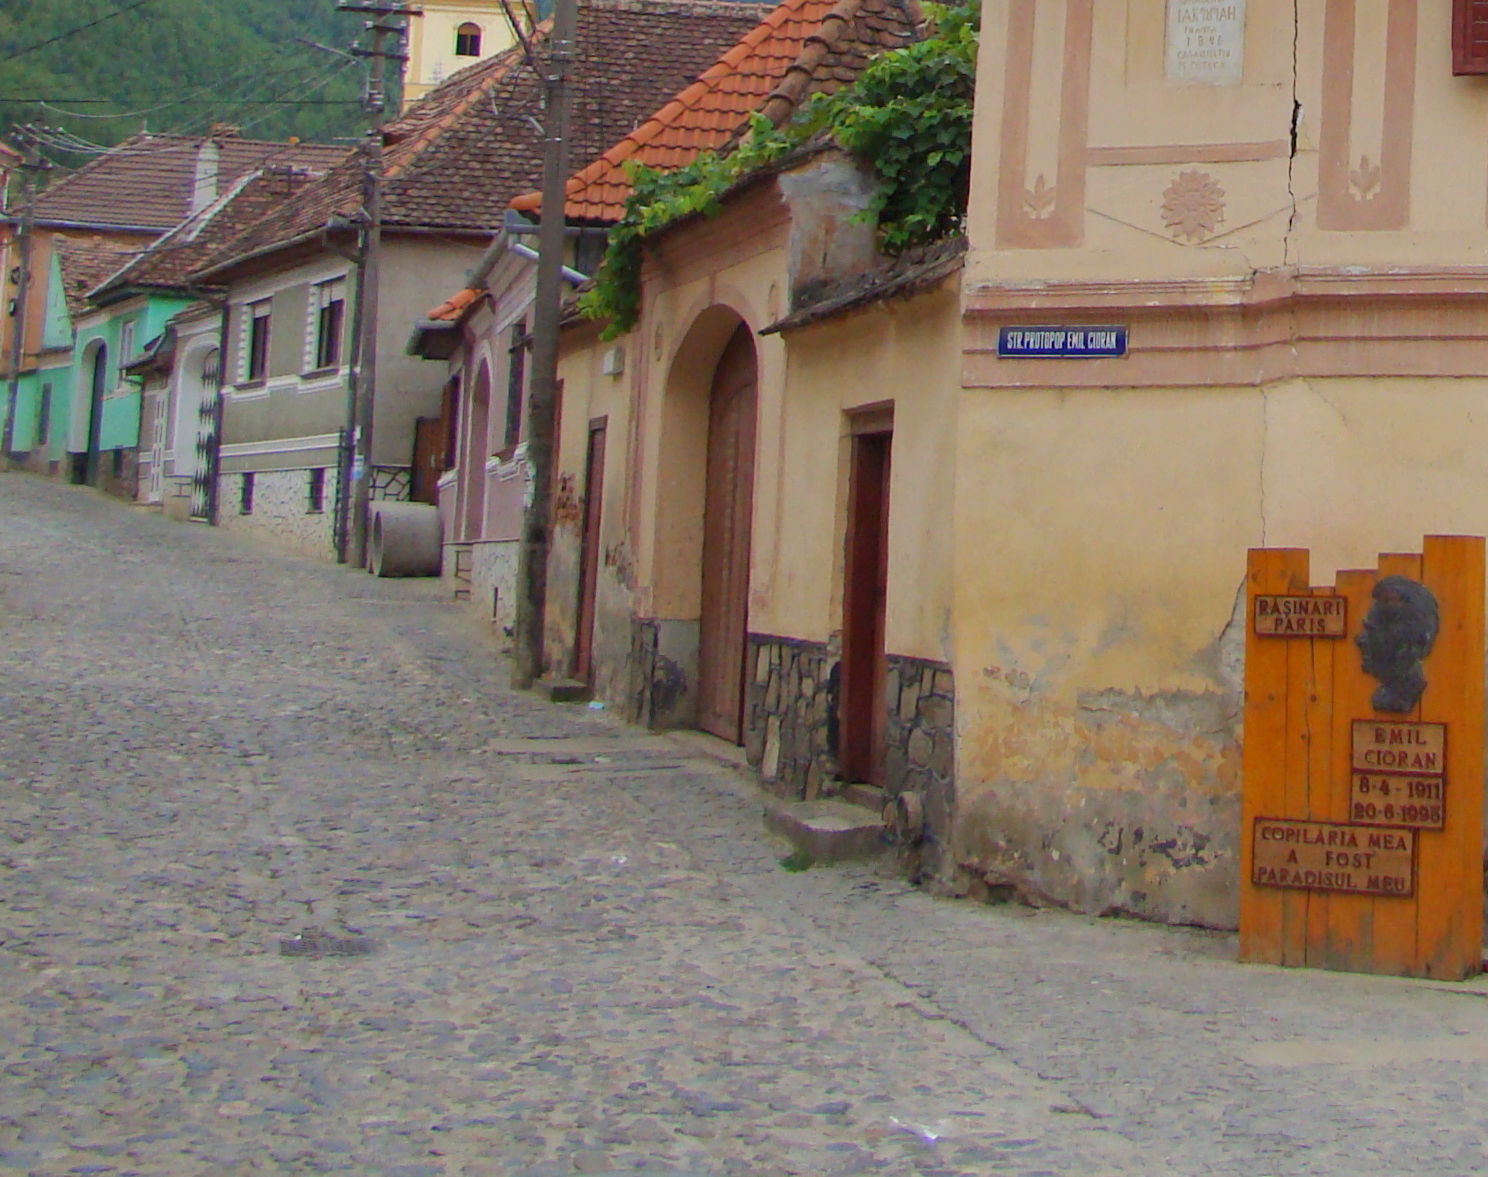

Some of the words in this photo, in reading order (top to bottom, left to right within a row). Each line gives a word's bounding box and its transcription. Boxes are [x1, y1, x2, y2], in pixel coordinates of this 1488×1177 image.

[1024, 331, 1065, 349] PROTOPOP
[1067, 331, 1085, 349] EMIL
[1088, 331, 1117, 349] CIORAN
[1274, 618, 1325, 632] PARIS
[1375, 727, 1427, 744] EMIL
[1364, 749, 1436, 769] CIORAN
[1368, 833, 1407, 850] MEA
[1287, 848, 1298, 864] A
[1325, 850, 1375, 869] FOST
[1257, 866, 1357, 888] PARADISUL
